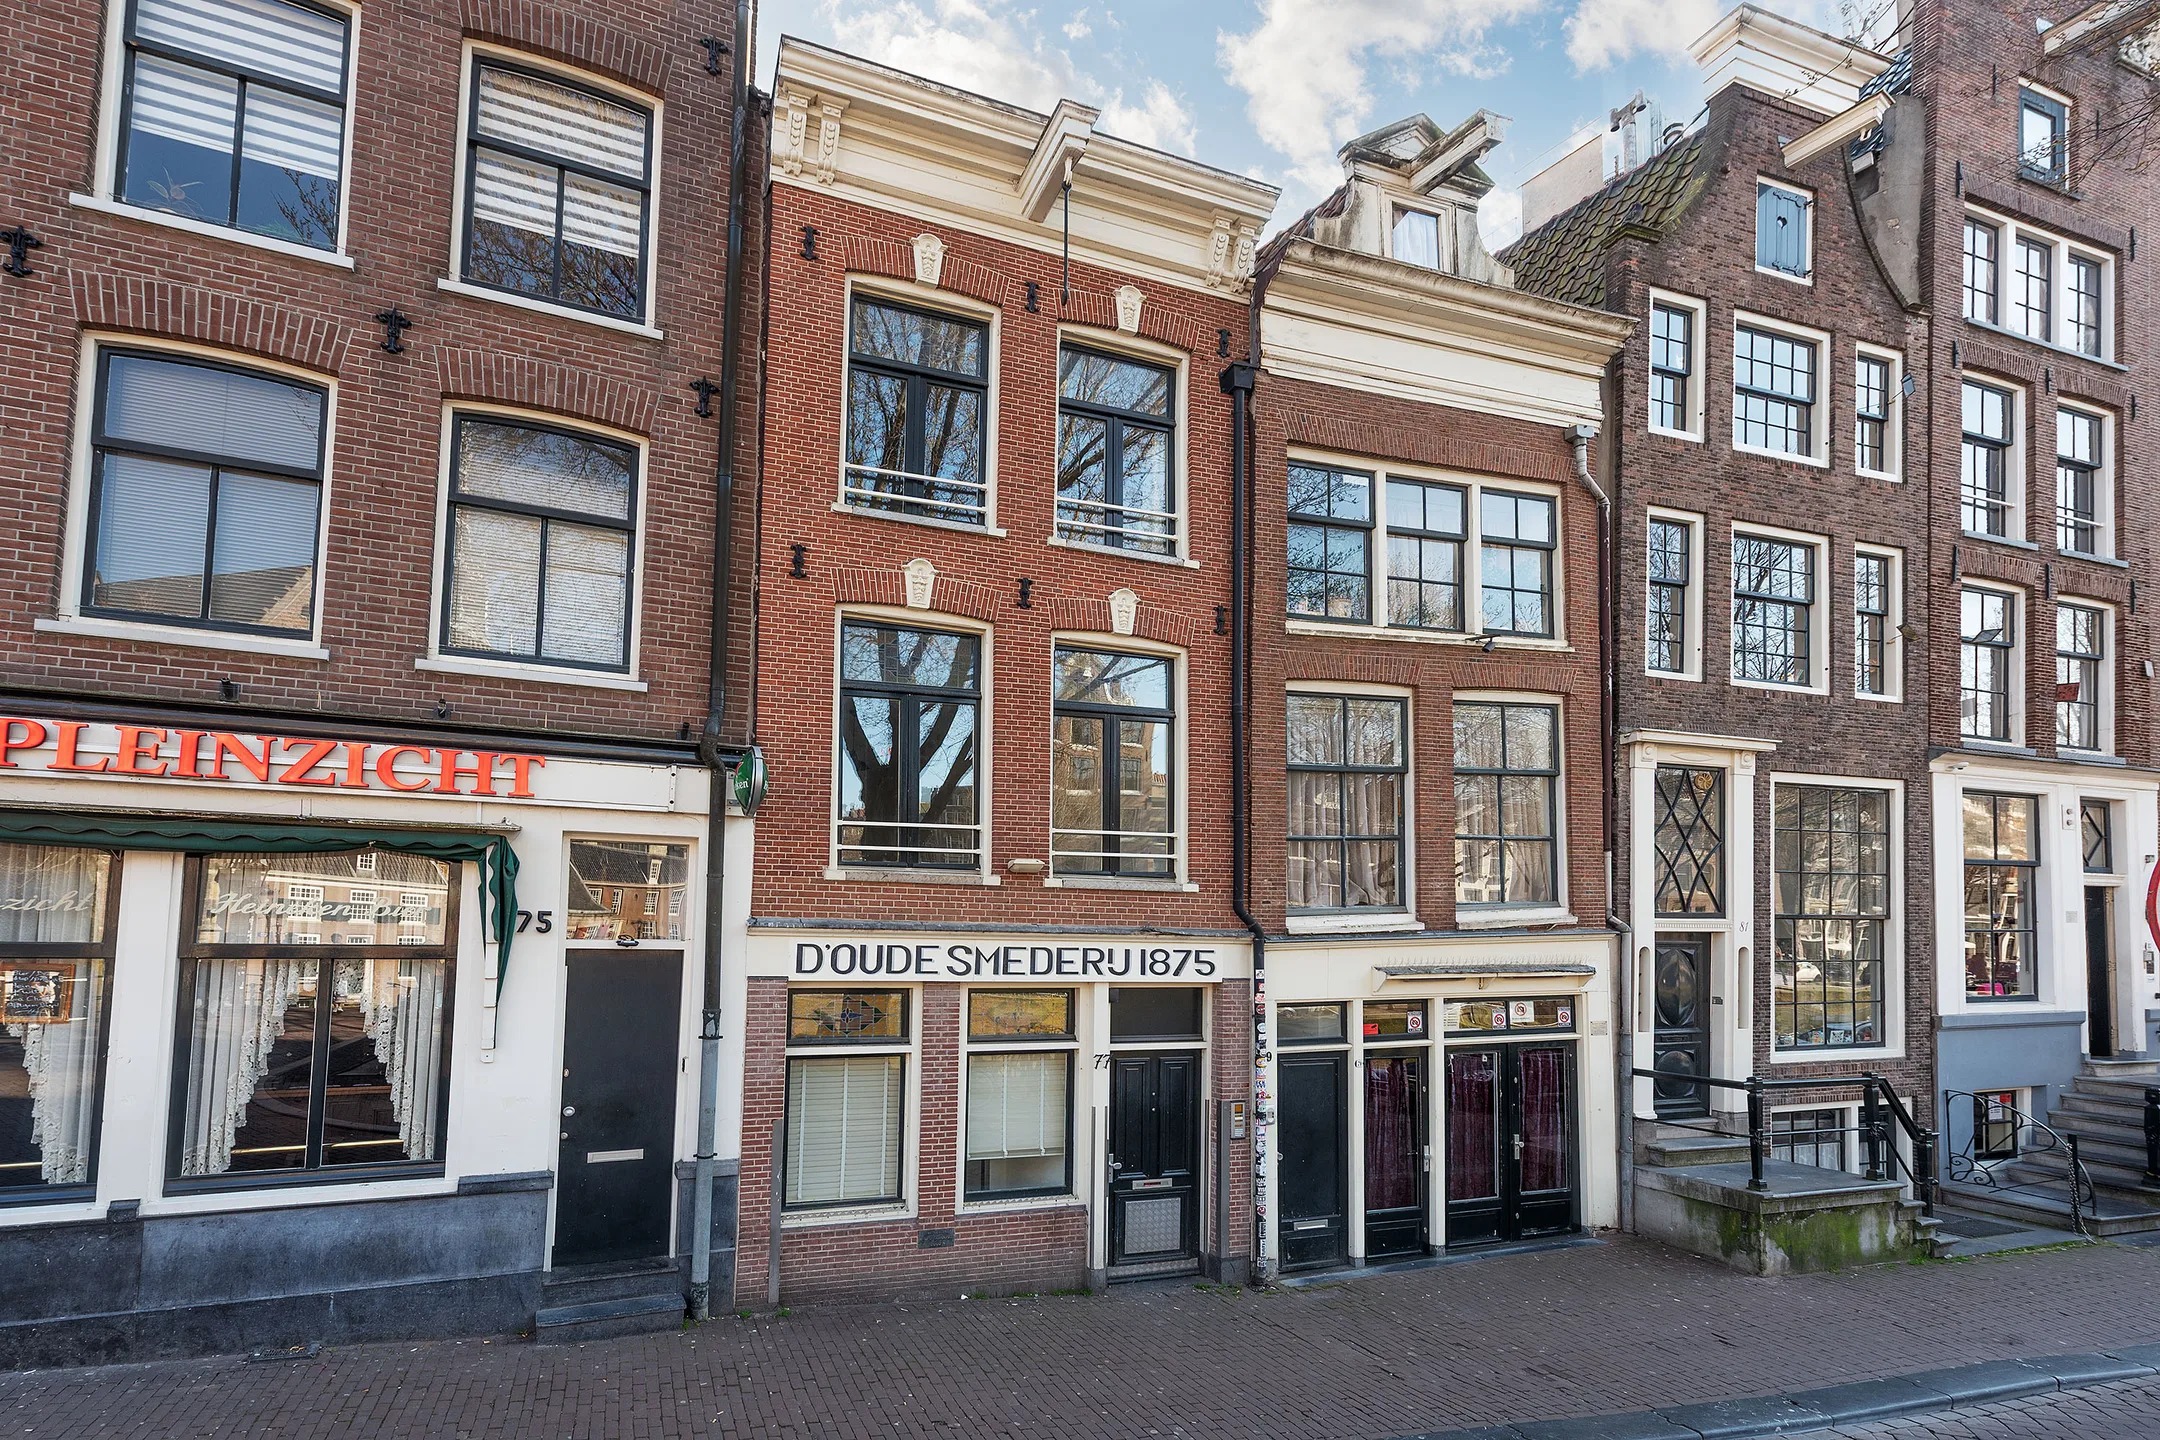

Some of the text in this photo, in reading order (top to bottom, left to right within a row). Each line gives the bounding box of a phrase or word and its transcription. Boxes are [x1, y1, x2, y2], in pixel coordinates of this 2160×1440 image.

[0, 717, 546, 797] PLEINZICHT
[0, 890, 94, 911] zicht
[211, 891, 433, 919] Heineken Bier
[517, 911, 552, 933] 75
[1739, 921, 1749, 933] 81
[795, 943, 1216, 976] D'OUDE SMEDERIJ 1875
[1093, 1054, 1110, 1069] 77
